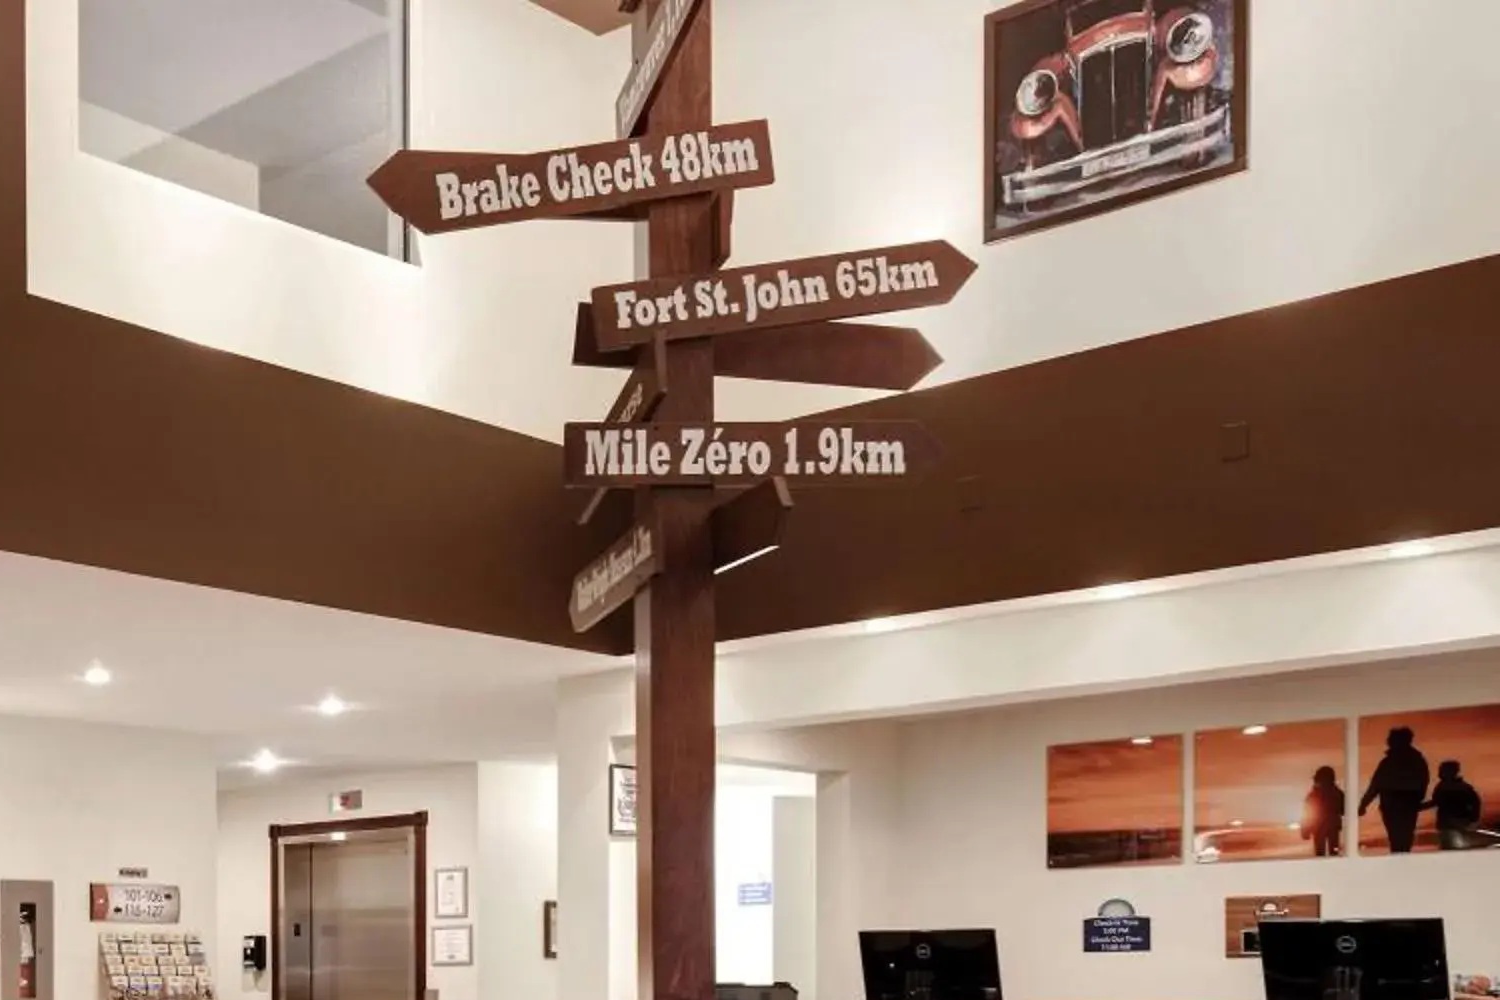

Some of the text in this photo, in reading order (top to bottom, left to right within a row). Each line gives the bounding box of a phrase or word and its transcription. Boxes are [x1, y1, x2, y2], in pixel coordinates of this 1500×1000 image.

[435, 131, 759, 220] Brake Check 48km
[614, 256, 940, 329] Fort St. John 65km
[585, 427, 906, 476] Mile Zéro 1.9km
